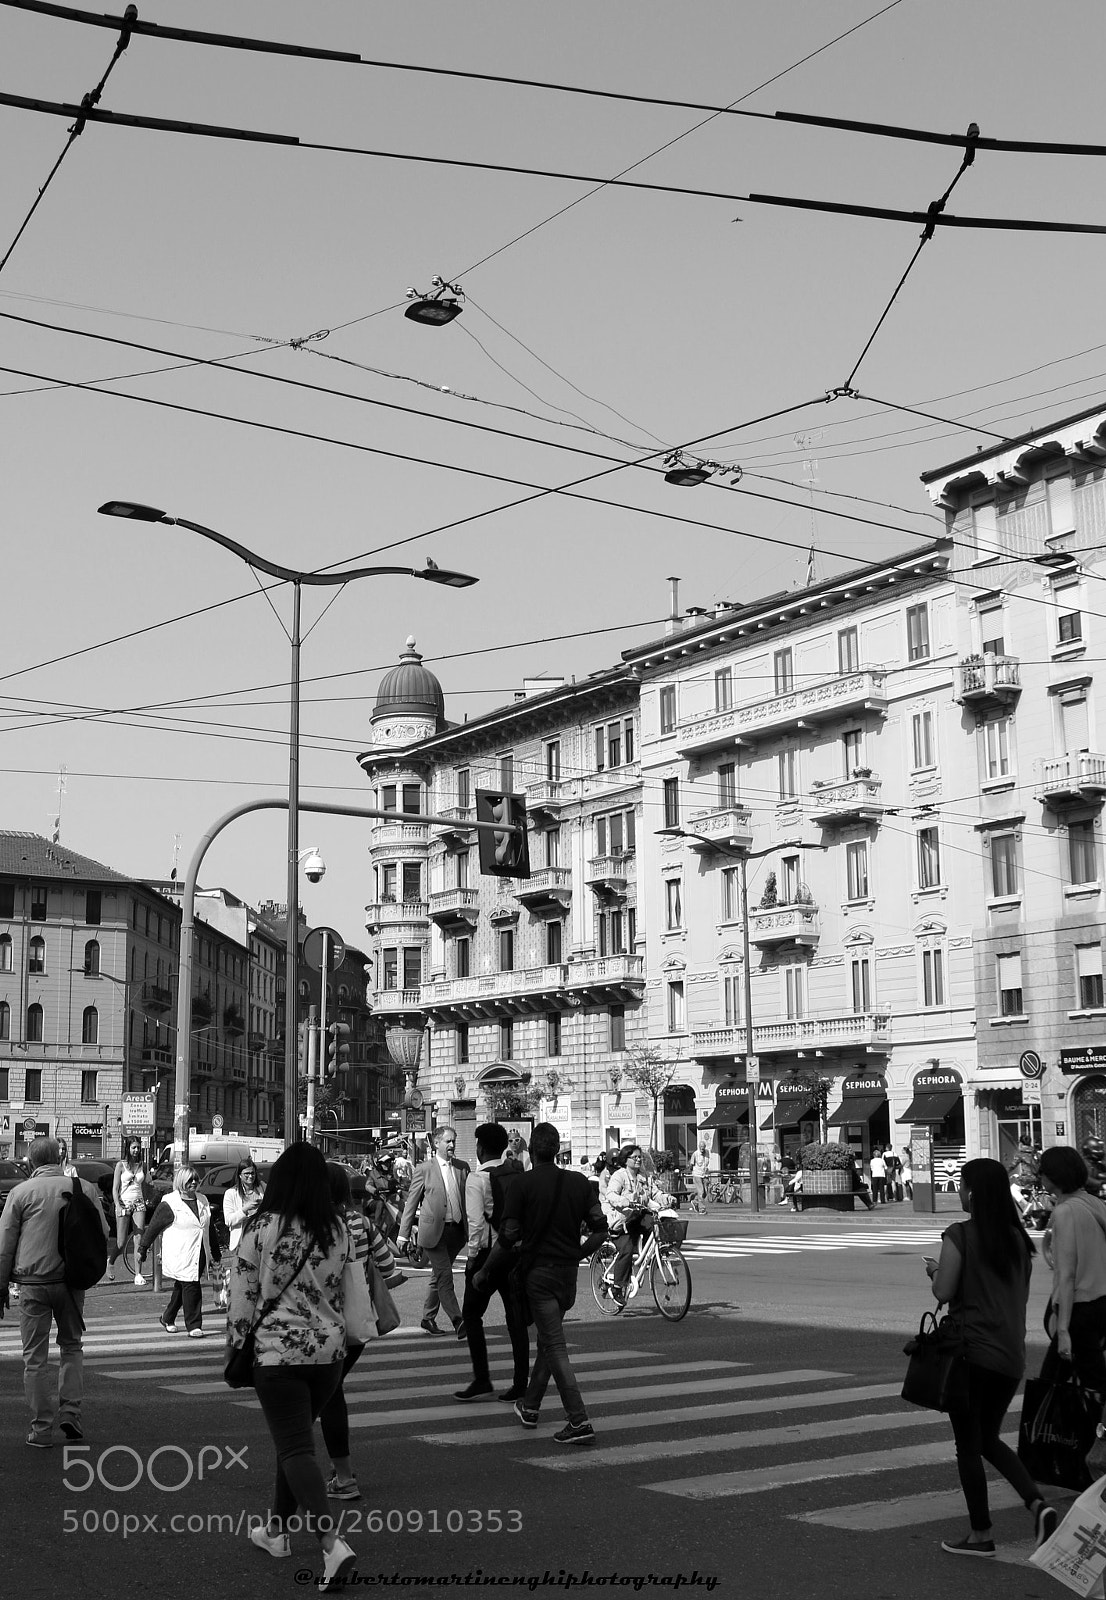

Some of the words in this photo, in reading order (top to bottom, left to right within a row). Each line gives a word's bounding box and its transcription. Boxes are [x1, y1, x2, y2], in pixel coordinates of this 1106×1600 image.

[1063, 1056, 1085, 1064] BAUME
[845, 1080, 882, 1090] SEPHORA
[917, 1075, 956, 1085] SEPHORA
[718, 1087, 749, 1097] SEPHORA
